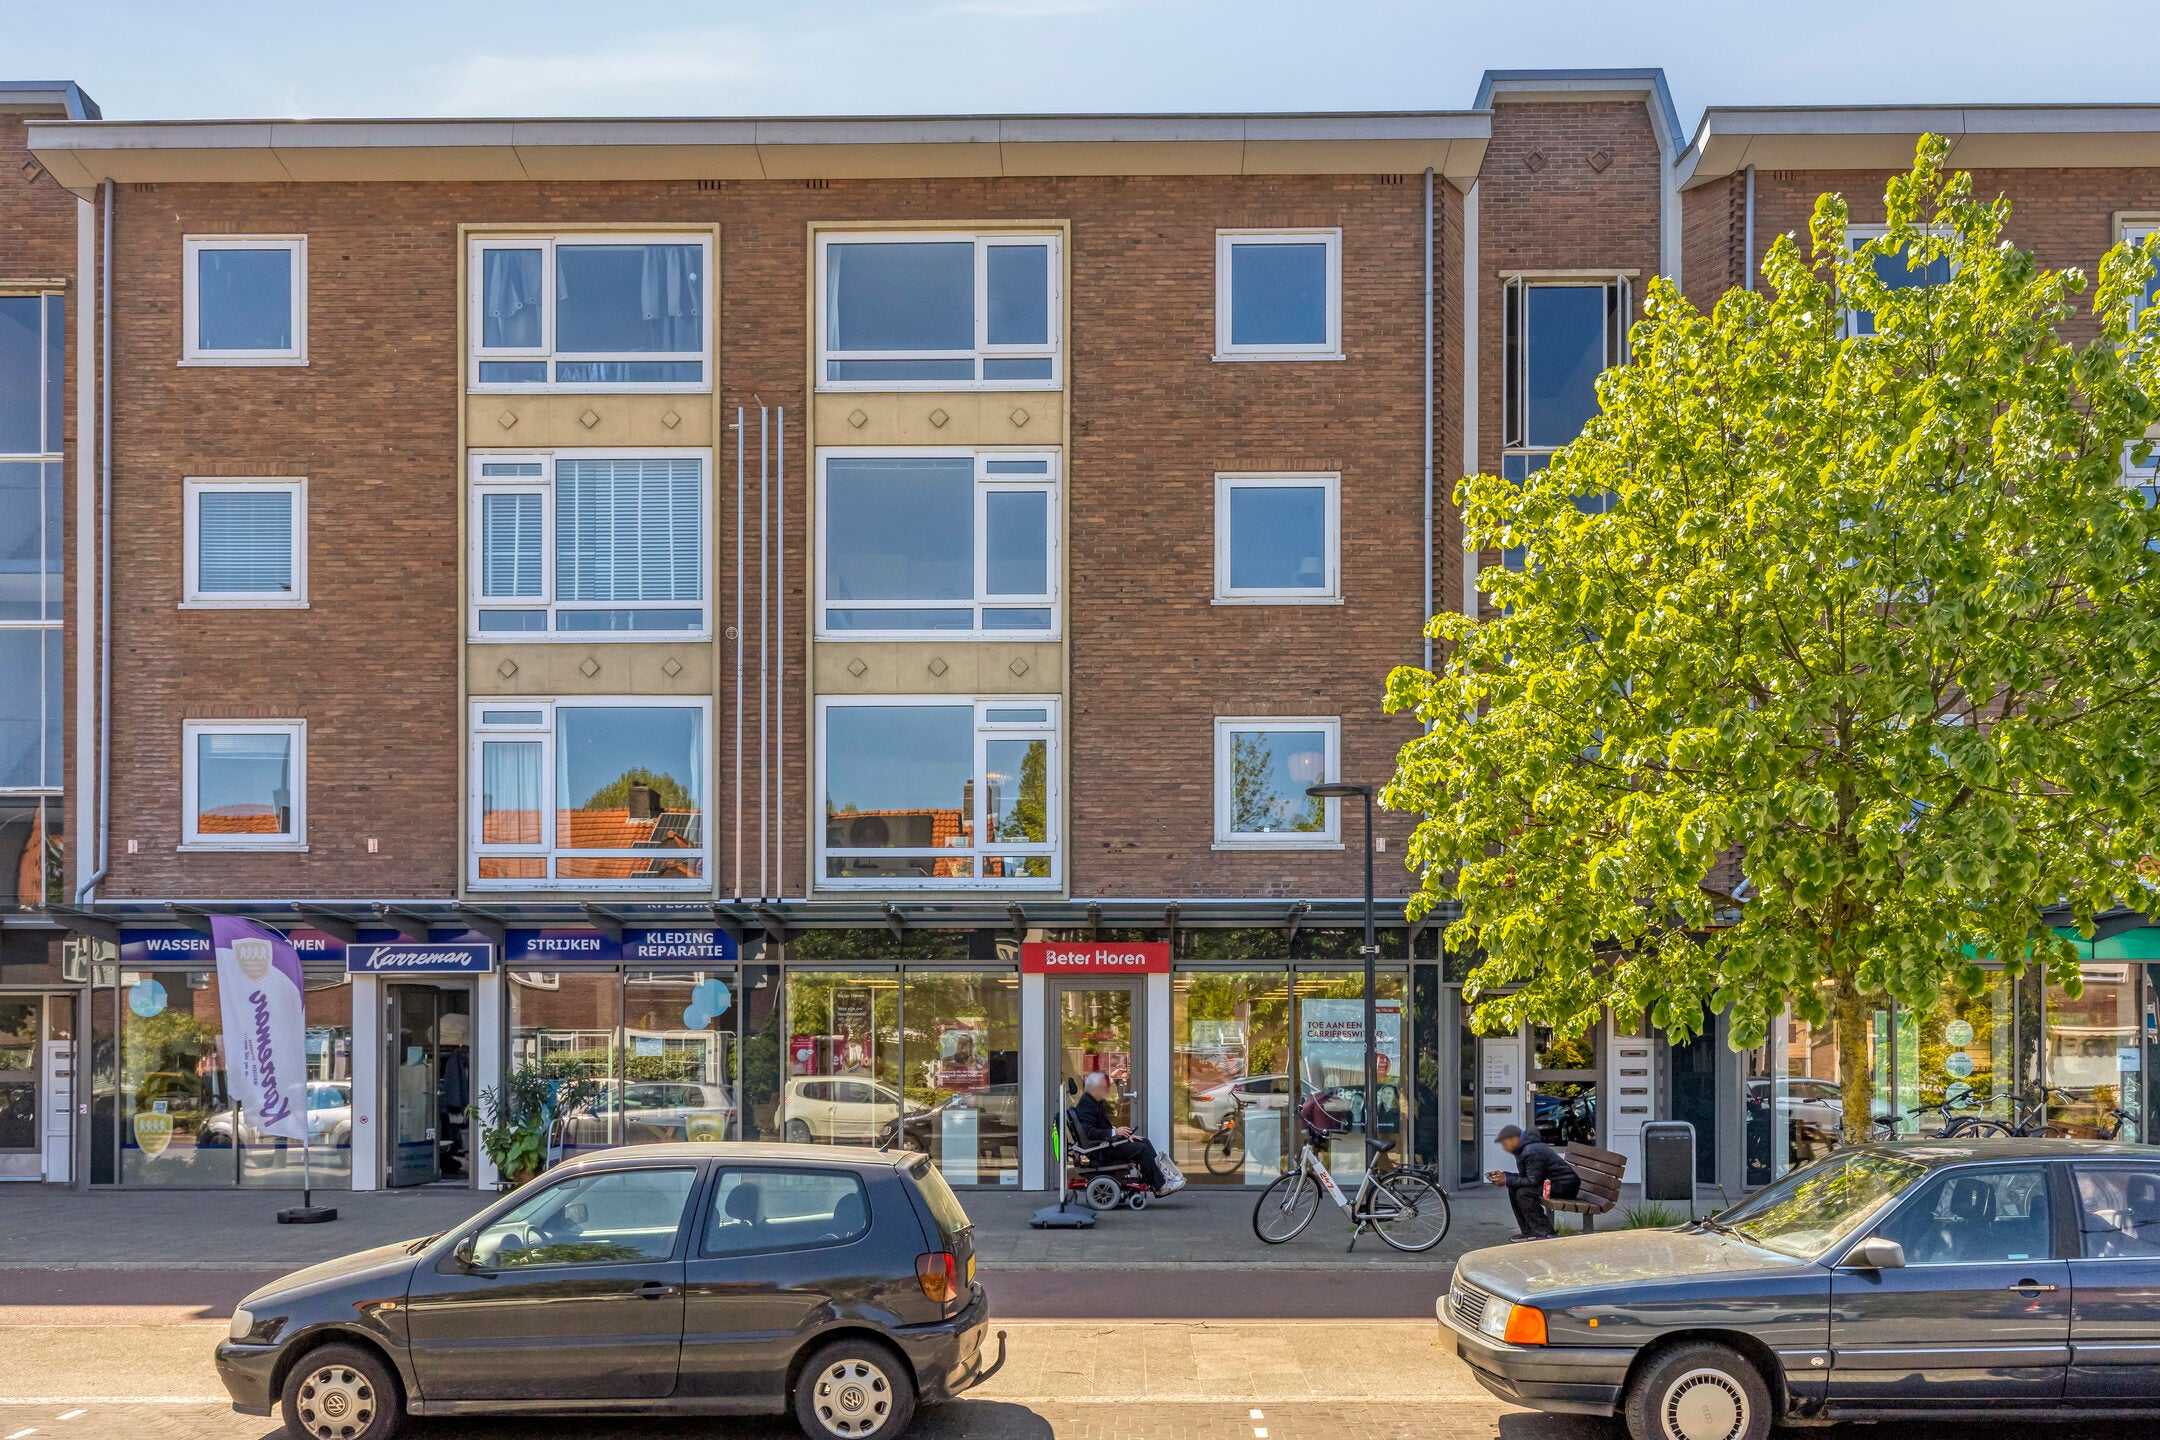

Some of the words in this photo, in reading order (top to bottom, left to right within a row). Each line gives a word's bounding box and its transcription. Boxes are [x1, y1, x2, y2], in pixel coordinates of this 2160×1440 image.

[646, 932, 714, 944] KLEDING
[146, 939, 210, 951] WASSEN
[284, 939, 325, 951] MEN
[527, 939, 601, 950] STRIJKEN
[638, 945, 723, 957] REPARATIE
[366, 946, 472, 970] Karreman
[1046, 950, 1091, 965] Beter
[1095, 950, 1146, 965] Horen
[1307, 1021, 1324, 1029] TOE
[1325, 1021, 1344, 1029] AAN
[1346, 1021, 1363, 1029] EEN
